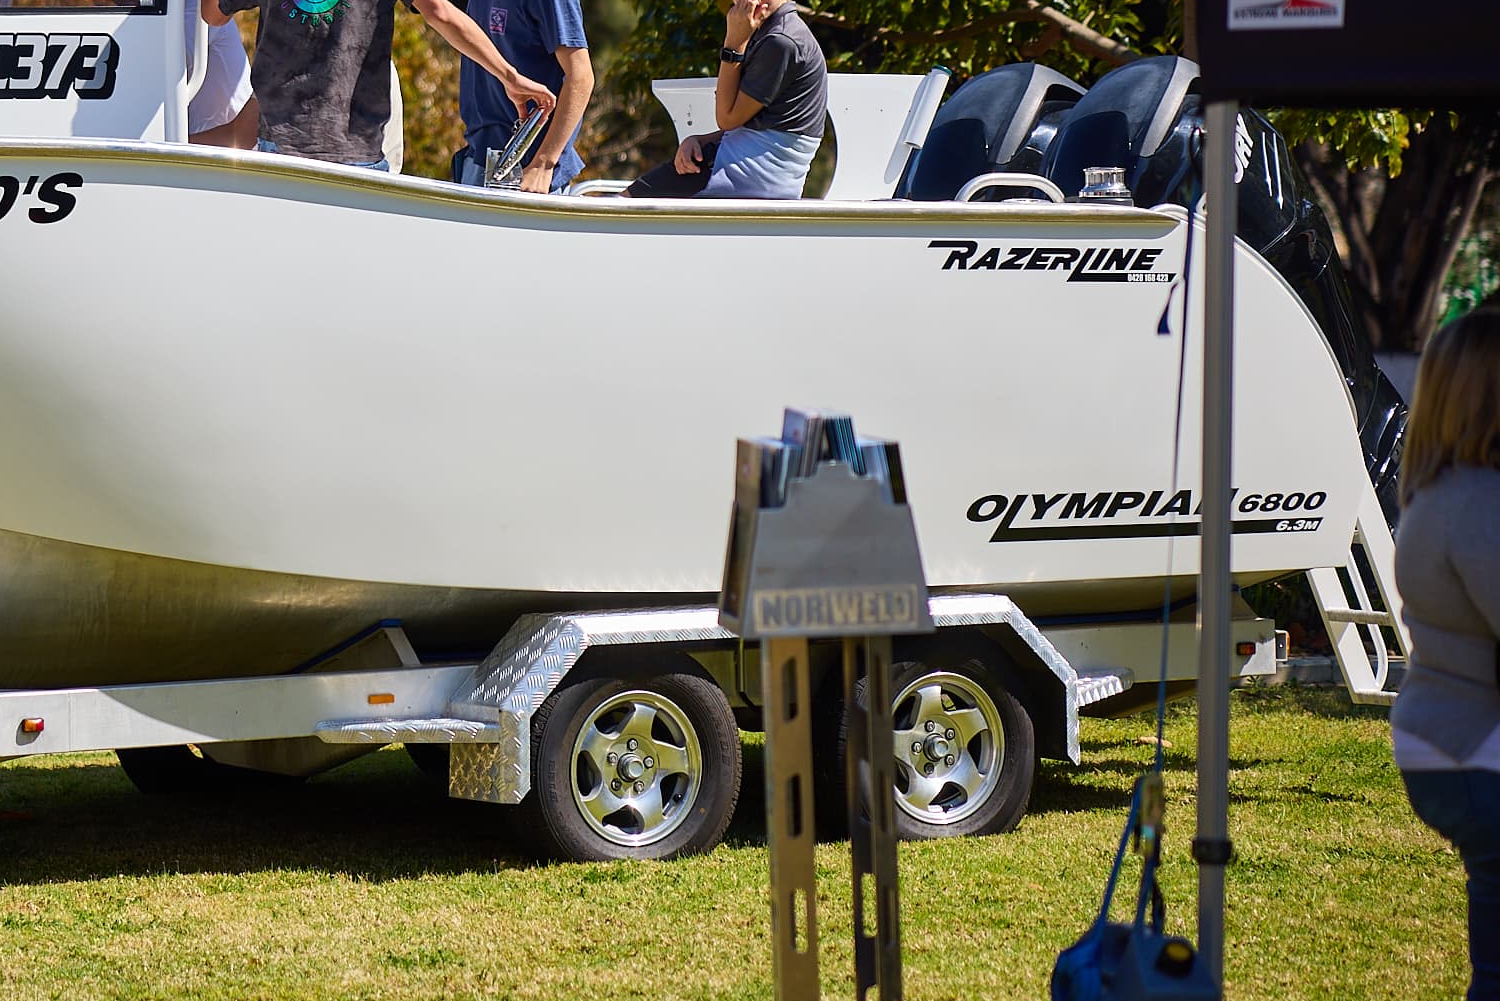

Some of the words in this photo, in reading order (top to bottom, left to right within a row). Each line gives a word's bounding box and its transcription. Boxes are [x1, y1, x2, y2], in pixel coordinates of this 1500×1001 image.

[927, 240, 1170, 283] RAZERLINE
[966, 488, 1239, 542] OLYMPIA
[1238, 491, 1327, 515] 6800
[1275, 519, 1319, 533] 6.3M
[761, 588, 912, 627] NORWELD
